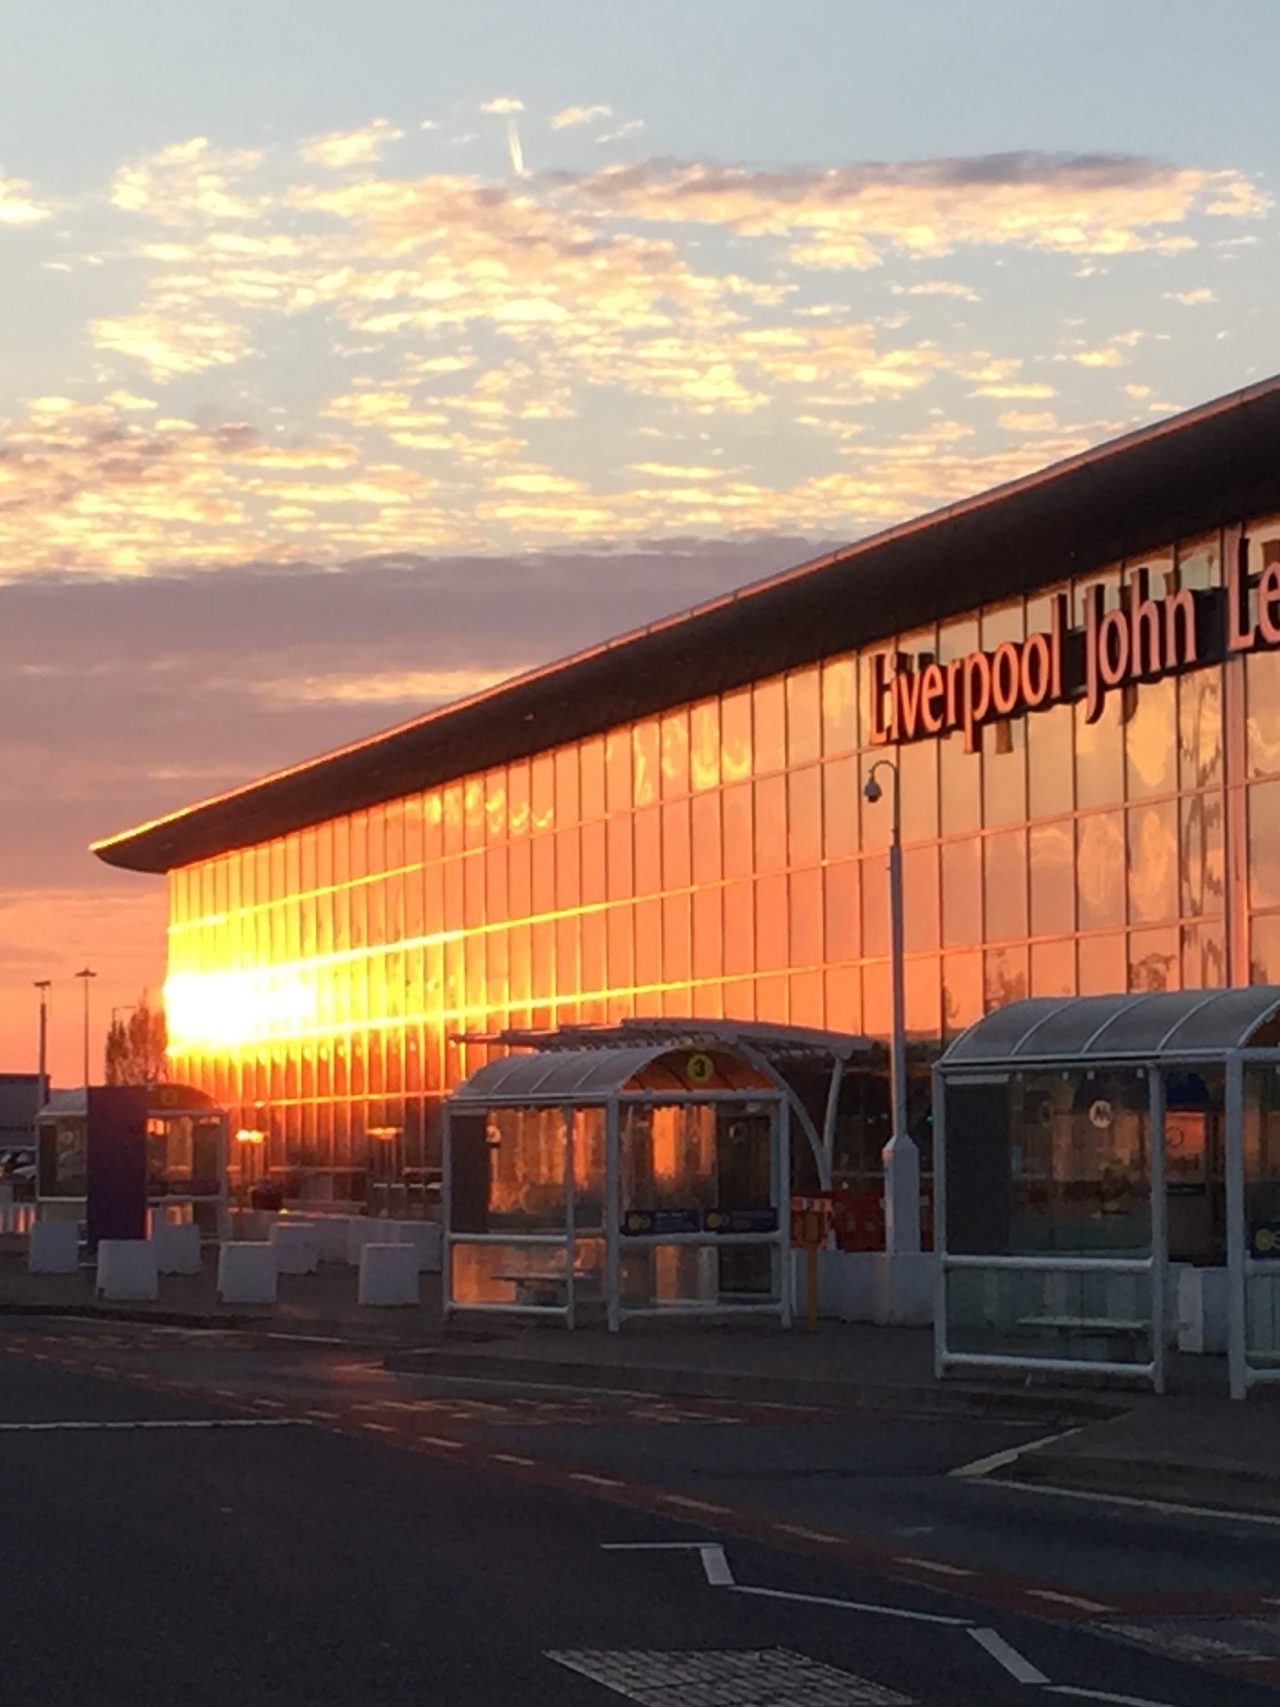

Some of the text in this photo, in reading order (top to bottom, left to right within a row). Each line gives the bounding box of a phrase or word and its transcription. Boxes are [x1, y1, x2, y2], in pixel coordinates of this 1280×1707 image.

[869, 594, 1066, 753] Liverpool
[1083, 568, 1197, 724] John
[693, 1060, 706, 1077] 3
